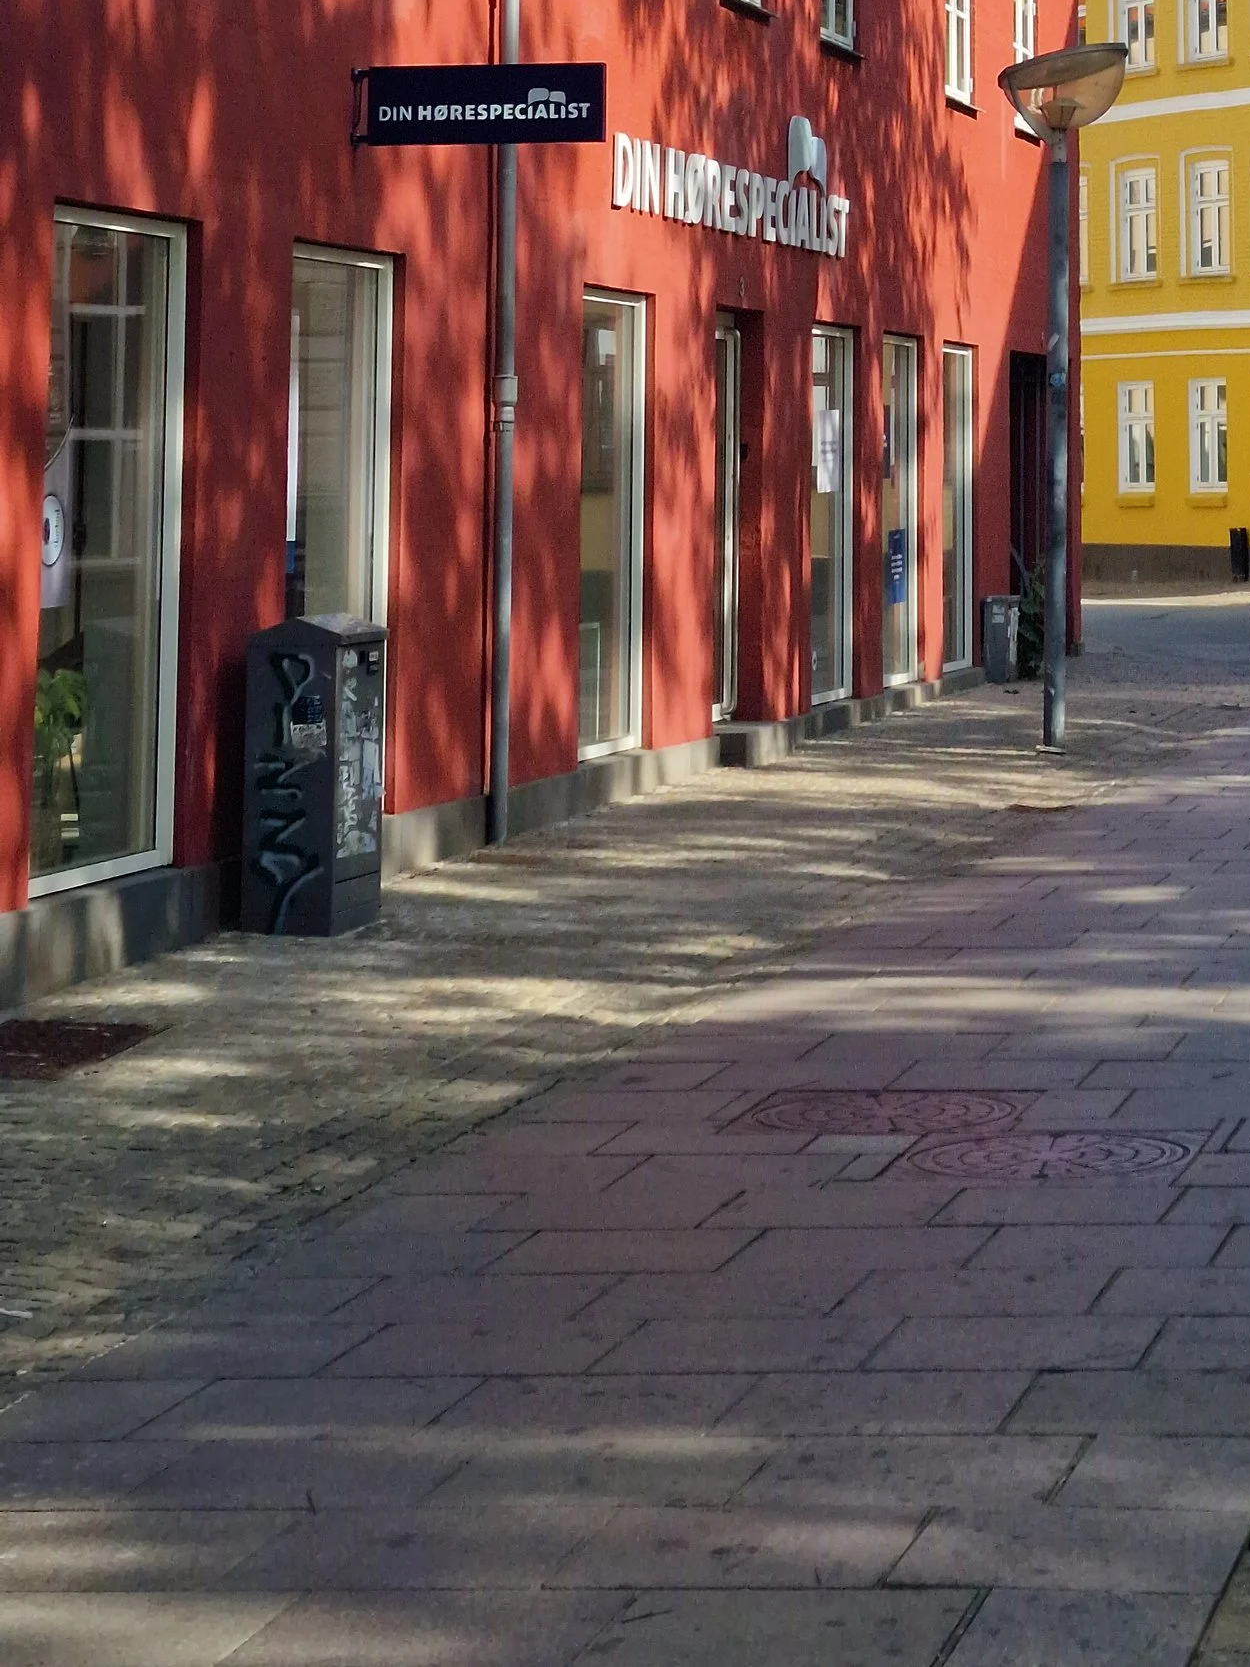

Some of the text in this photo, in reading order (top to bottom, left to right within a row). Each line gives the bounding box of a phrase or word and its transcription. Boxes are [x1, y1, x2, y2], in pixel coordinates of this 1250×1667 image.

[379, 103, 590, 121] DIN HØRESPECIALIST
[613, 132, 850, 258] DIN HØRESPECIALIST
